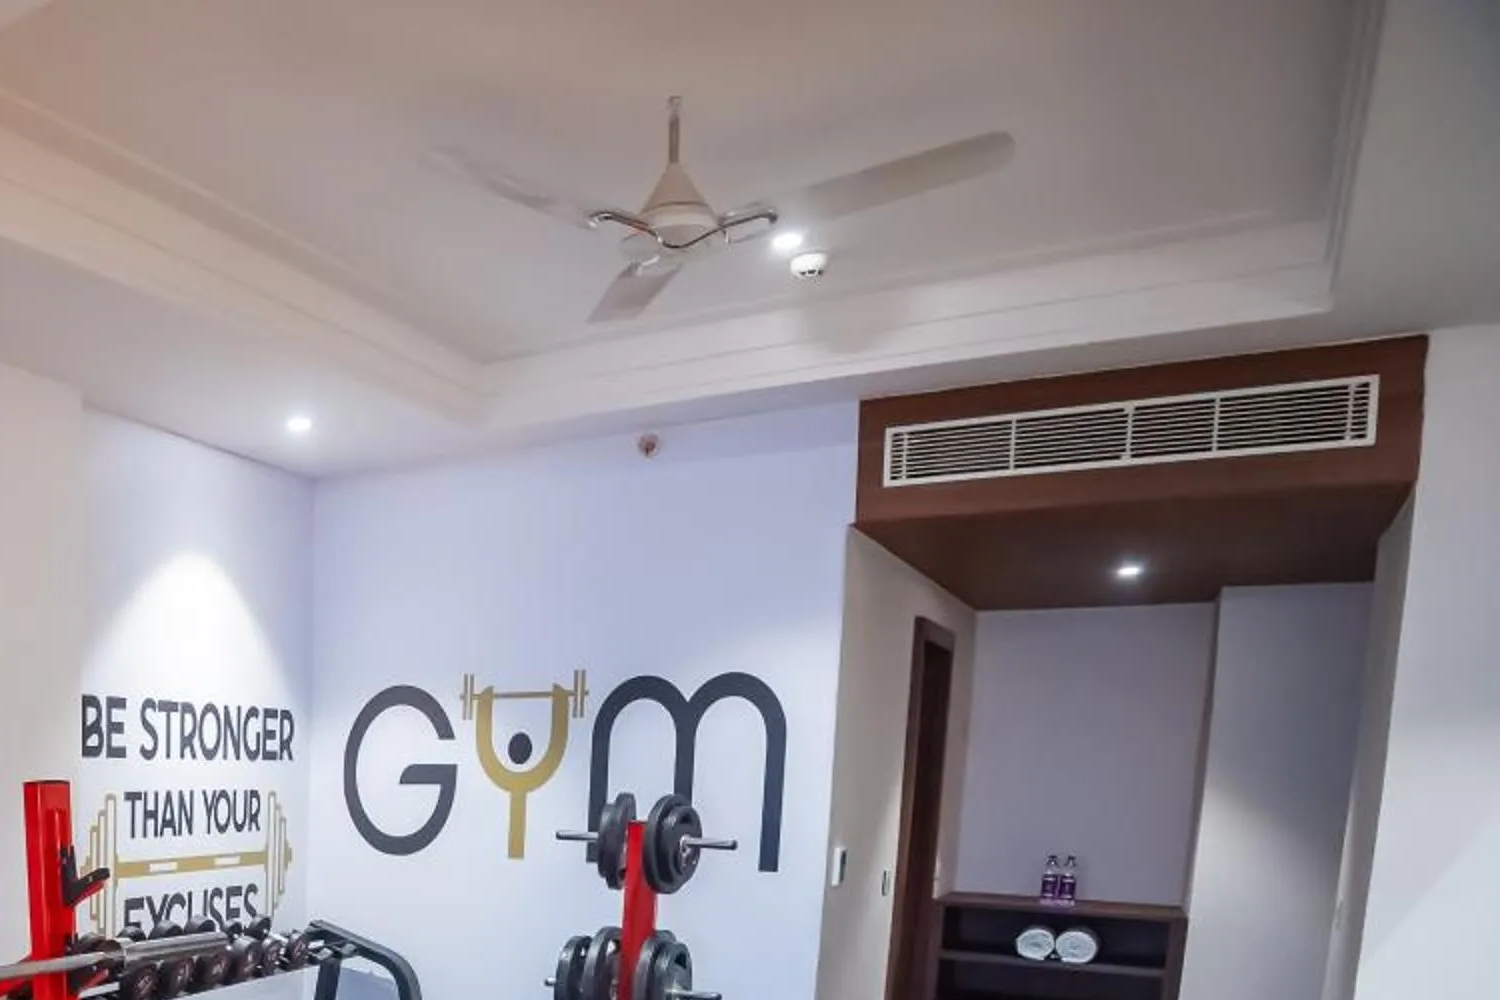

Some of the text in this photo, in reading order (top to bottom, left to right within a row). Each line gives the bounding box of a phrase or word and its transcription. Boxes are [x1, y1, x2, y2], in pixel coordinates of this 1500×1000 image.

[82, 694, 294, 760] BE STRONGER
[124, 789, 261, 839] THAN YOUR
